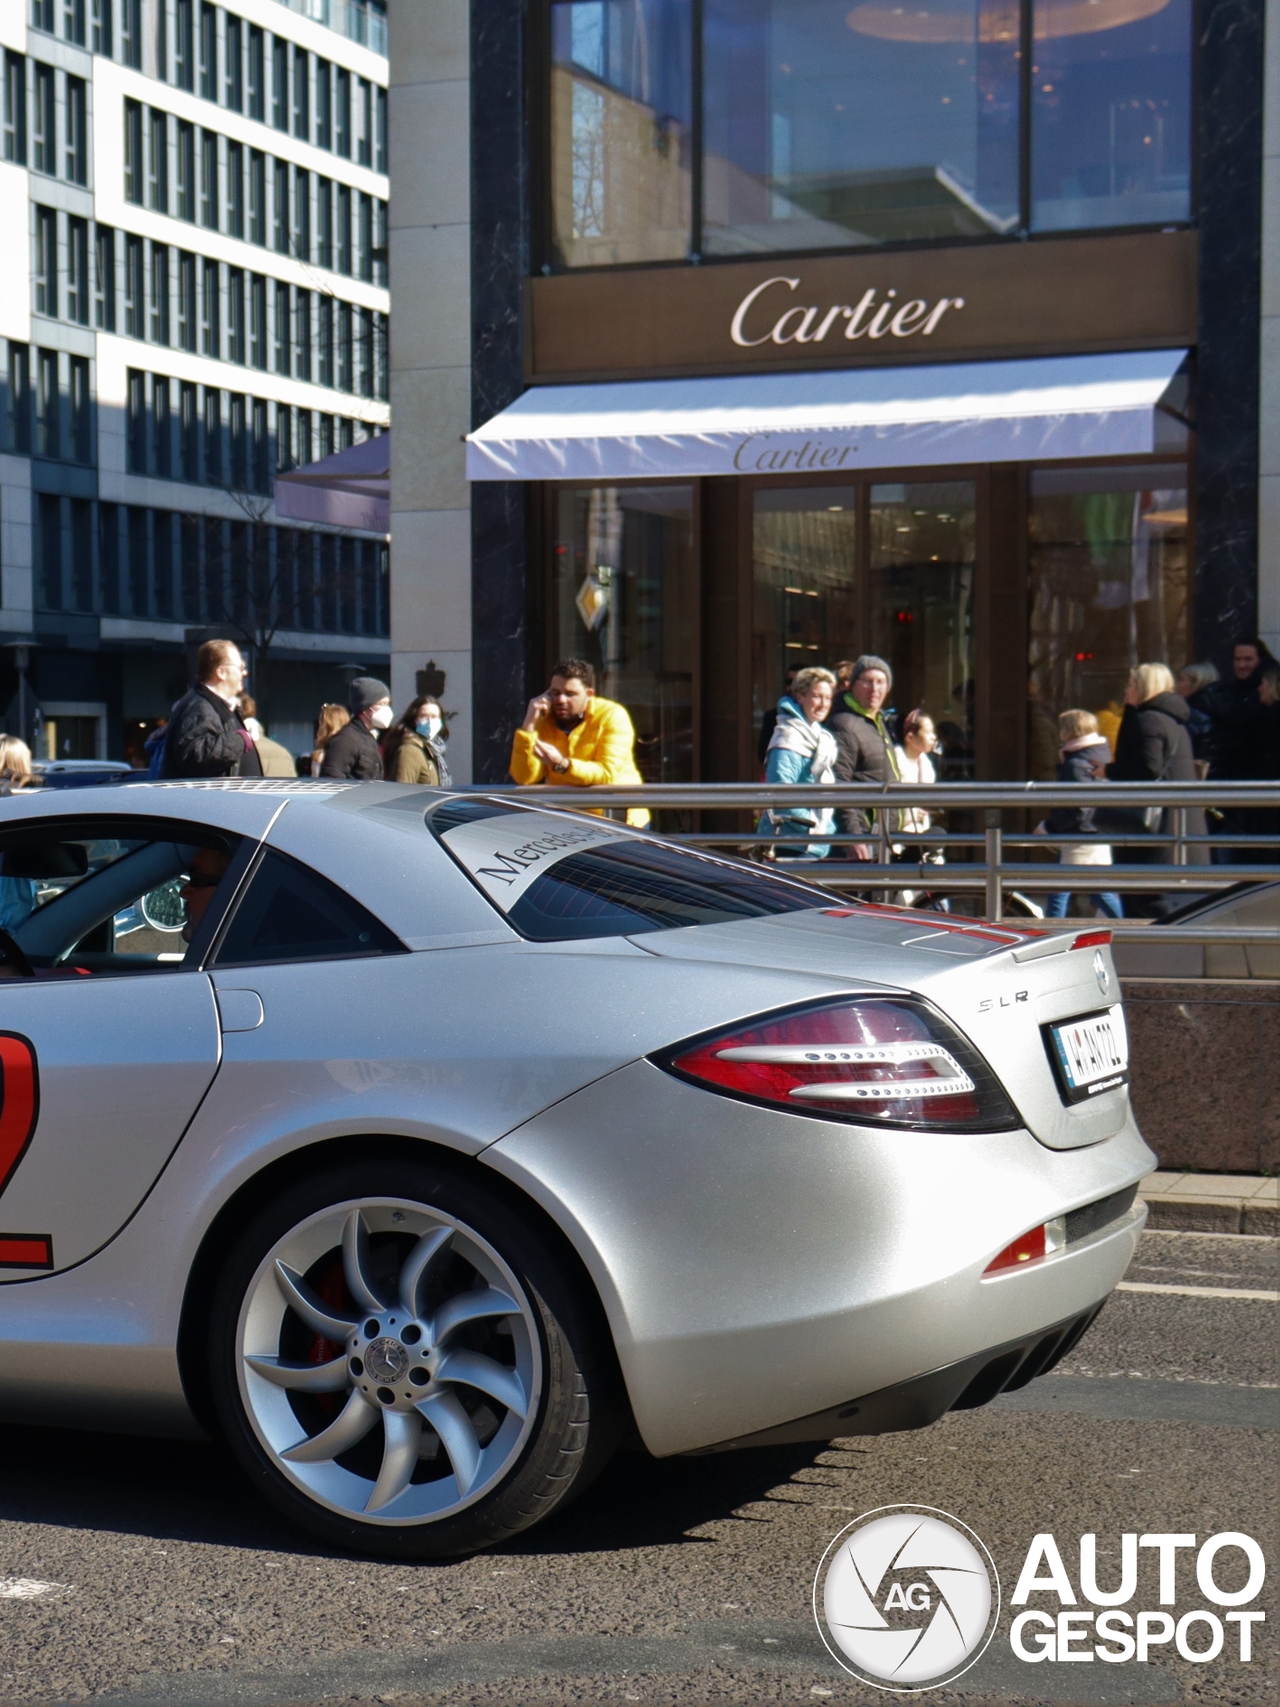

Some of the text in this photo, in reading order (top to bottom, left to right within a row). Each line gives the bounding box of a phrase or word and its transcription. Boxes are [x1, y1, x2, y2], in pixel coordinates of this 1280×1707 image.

[731, 277, 964, 346] Cartier
[733, 435, 860, 471] Cartier
[978, 990, 1029, 1013] SLR
